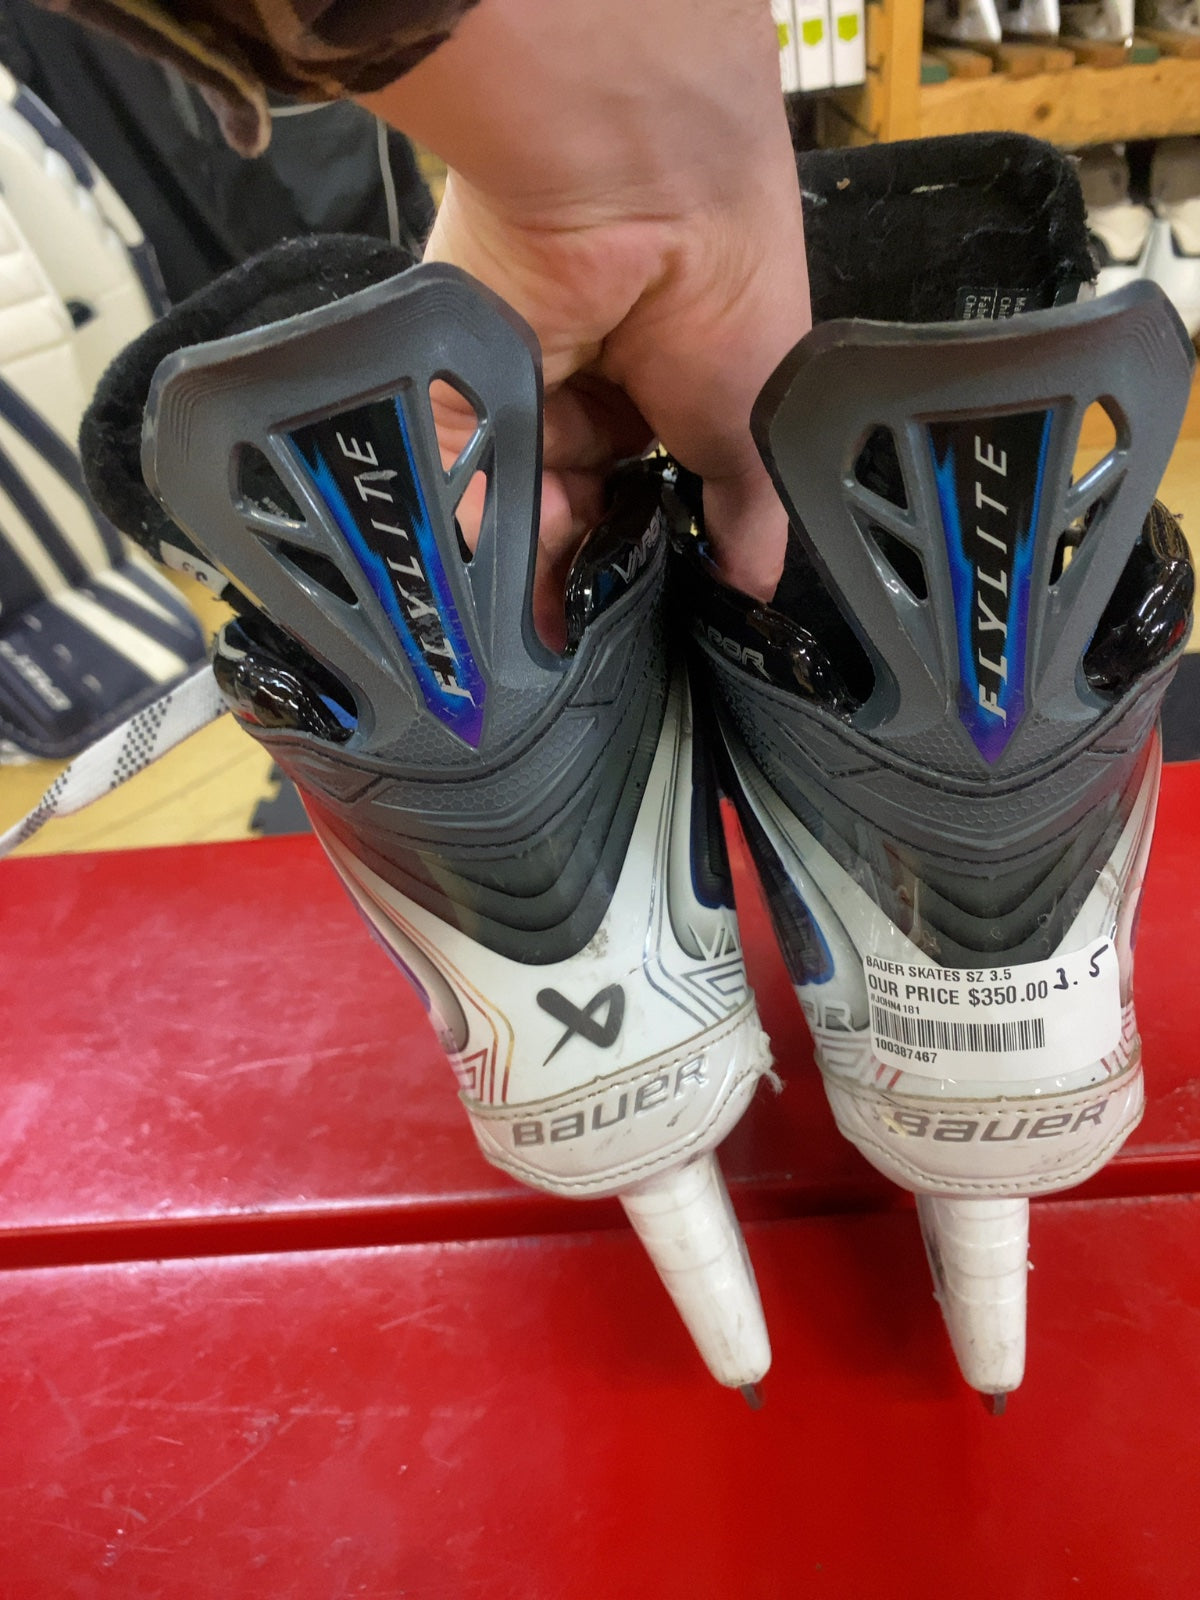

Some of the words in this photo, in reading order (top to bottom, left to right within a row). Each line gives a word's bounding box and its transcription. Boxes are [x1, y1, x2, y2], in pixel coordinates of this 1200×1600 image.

[336, 432, 475, 707] FLYLITE
[974, 435, 1008, 728] FLYLITE
[866, 955, 905, 976] BAUER
[909, 966, 961, 982] SKATES
[966, 971, 984, 982] SZ
[990, 968, 1012, 981] 3.5
[868, 974, 899, 998] OUR
[905, 984, 960, 1005] PRICE
[968, 980, 1048, 1007] $350.00
[875, 1037, 938, 1064] 100387467
